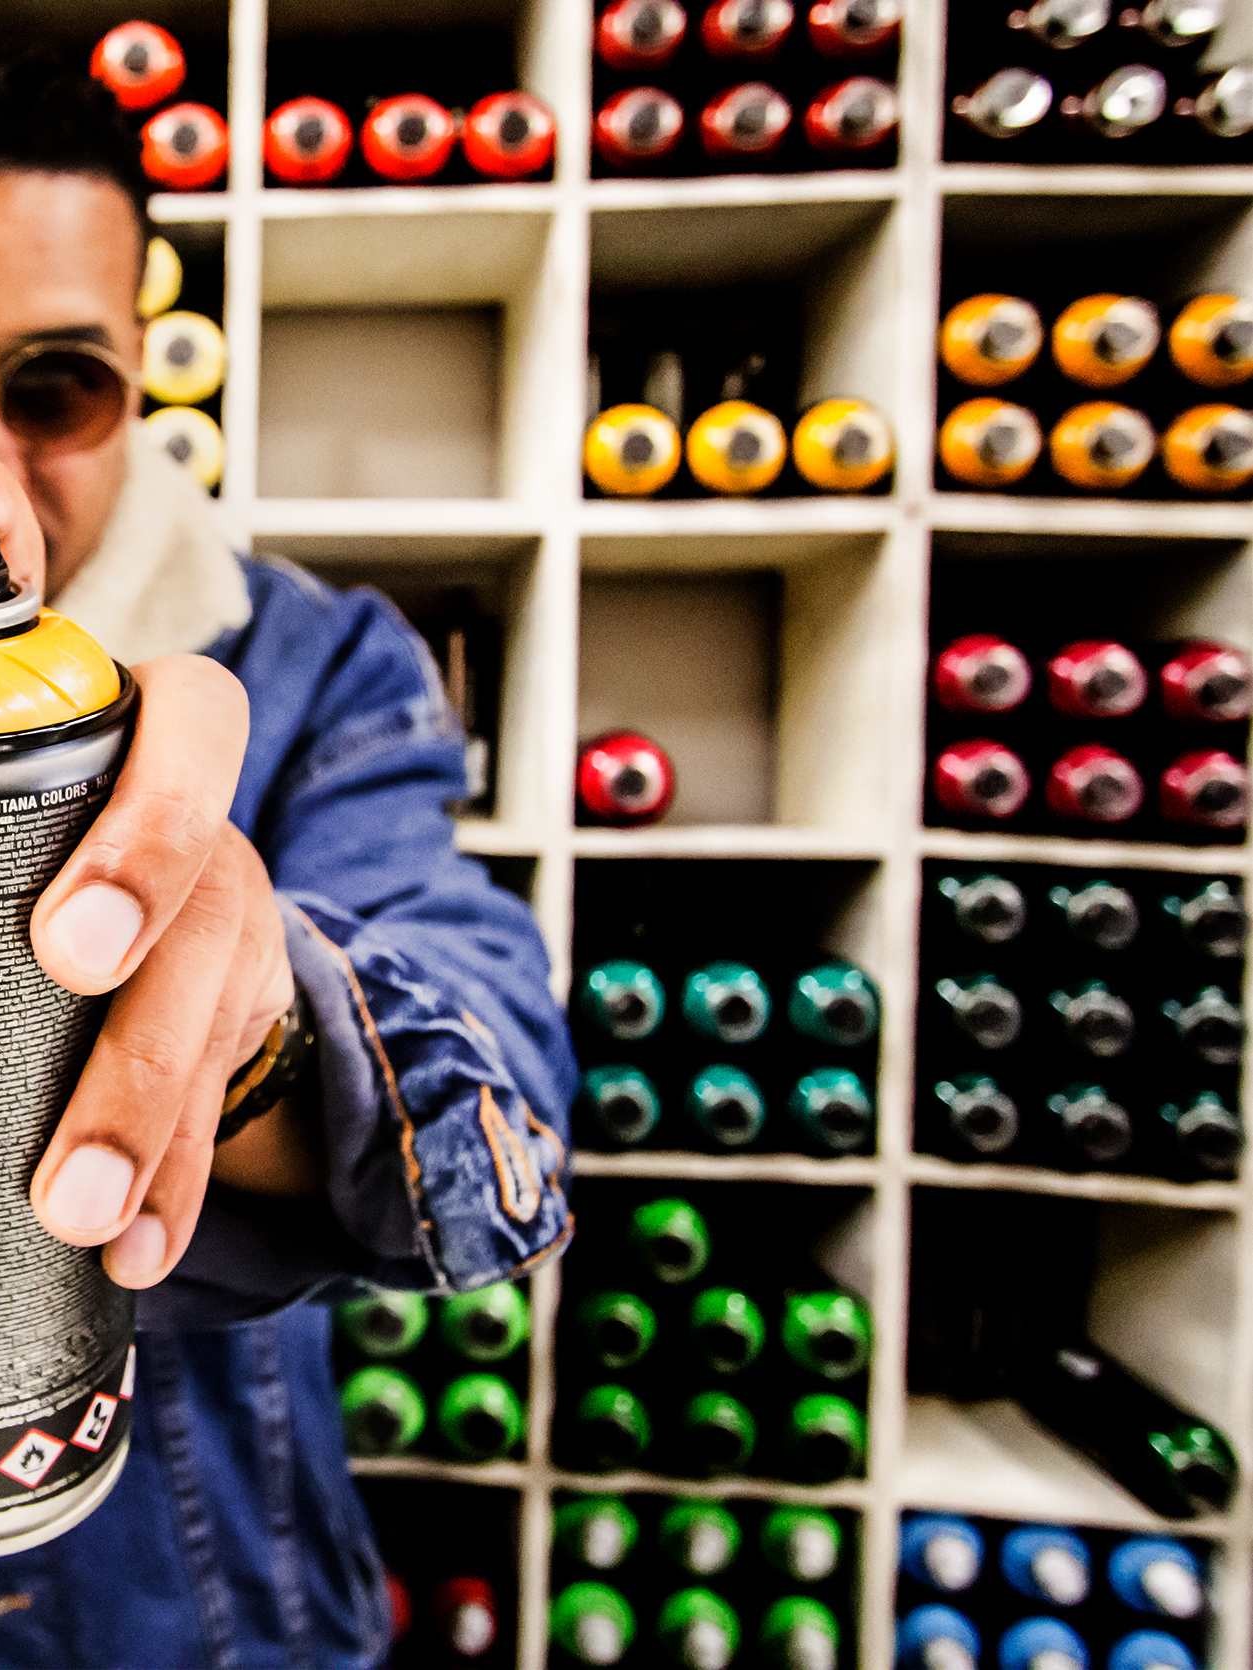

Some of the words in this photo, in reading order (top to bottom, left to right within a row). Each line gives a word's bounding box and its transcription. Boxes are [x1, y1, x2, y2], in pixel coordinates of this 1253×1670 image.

[41, 782, 88, 806] COLORS
[6, 824, 20, 833] May
[4, 833, 14, 842] and
